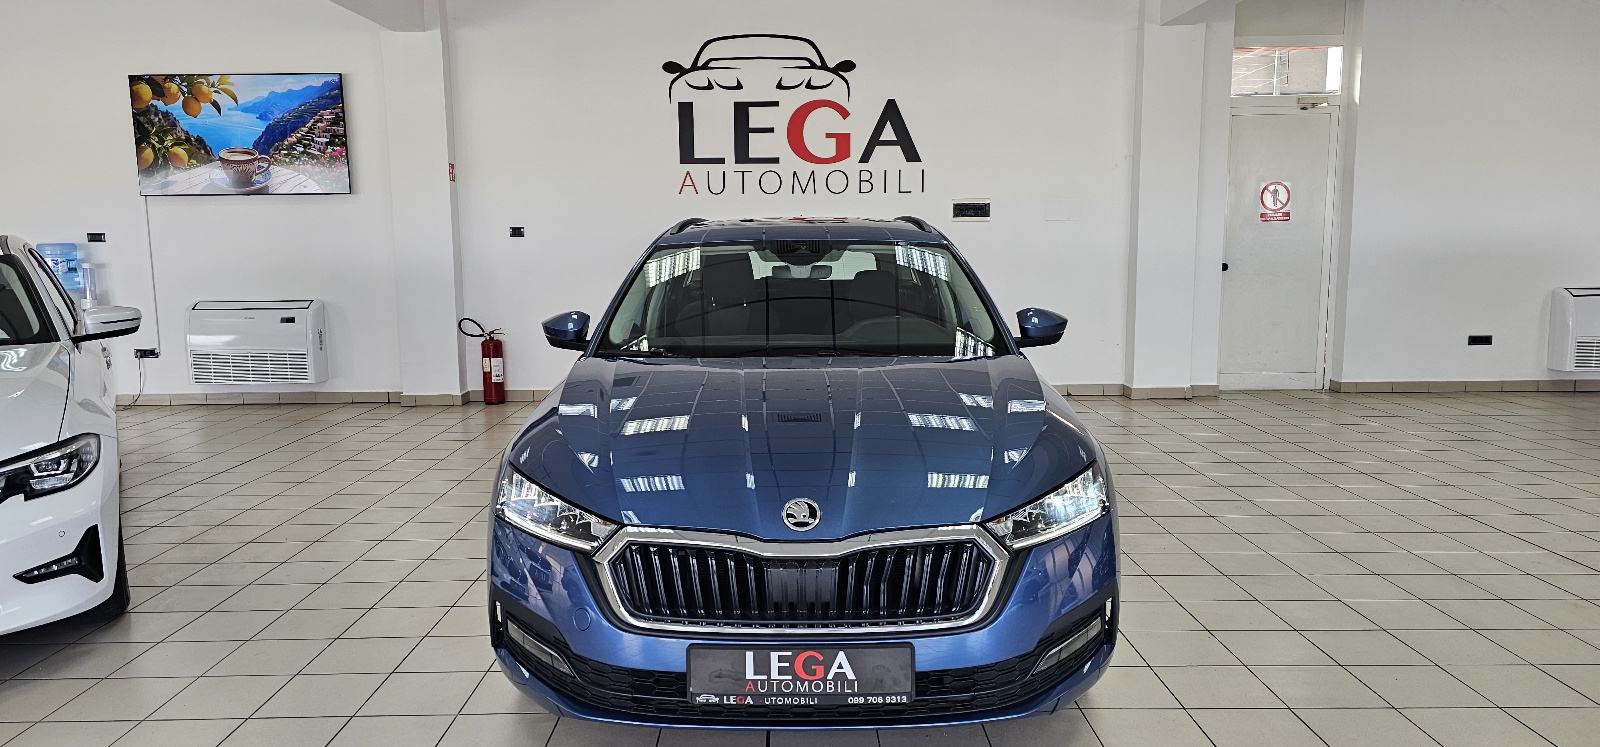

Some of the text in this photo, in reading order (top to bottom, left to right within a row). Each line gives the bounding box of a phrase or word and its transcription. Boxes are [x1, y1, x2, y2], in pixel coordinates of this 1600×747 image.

[677, 99, 922, 164] LEGA
[678, 169, 925, 195] AUTOMOBILI
[745, 651, 856, 680] LEGA
[745, 681, 858, 693] AUTOMOBILI
[760, 697, 818, 705] UTOMOBILI
[867, 696, 883, 704] 706
[885, 695, 907, 704] 9313
